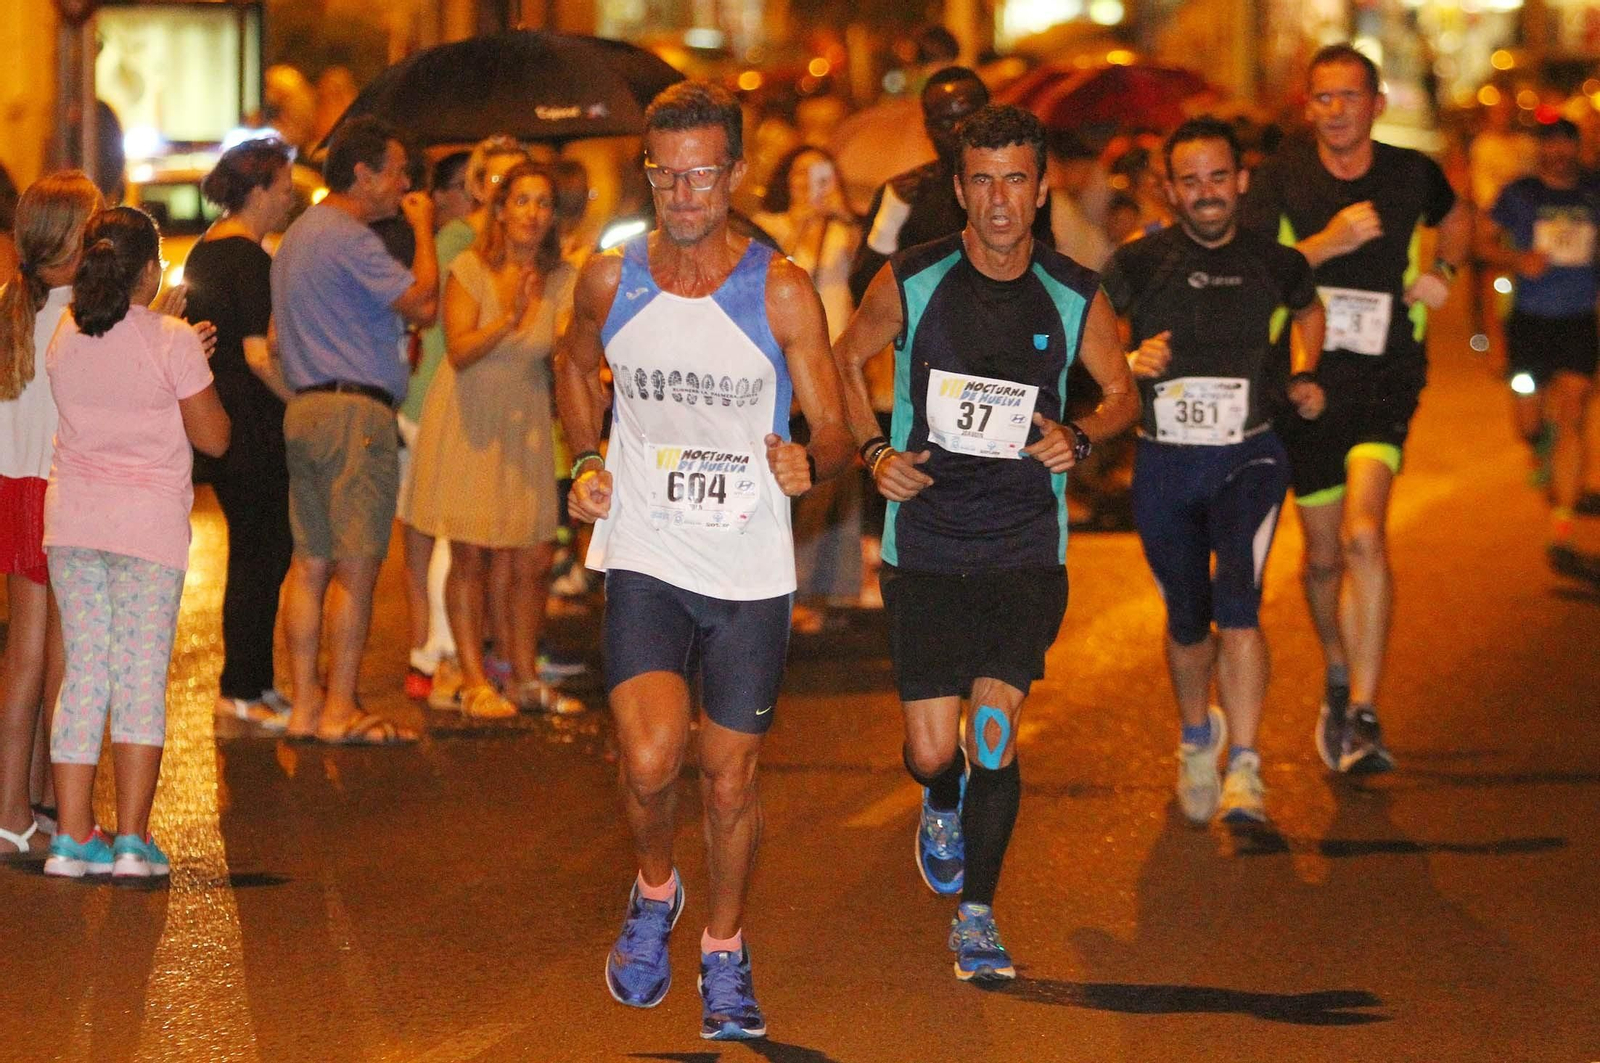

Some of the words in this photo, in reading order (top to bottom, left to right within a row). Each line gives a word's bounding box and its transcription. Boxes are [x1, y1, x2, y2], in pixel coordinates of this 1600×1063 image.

[964, 381, 1027, 398] NOCTURNA
[959, 390, 978, 401] DE
[978, 393, 1022, 407] HUELVA
[957, 402, 993, 432] 37
[1174, 400, 1218, 424] 361
[680, 449, 750, 464] NOCTURNA
[677, 460, 696, 472] DE
[697, 461, 747, 473] HUELVA
[667, 471, 727, 505] 604
